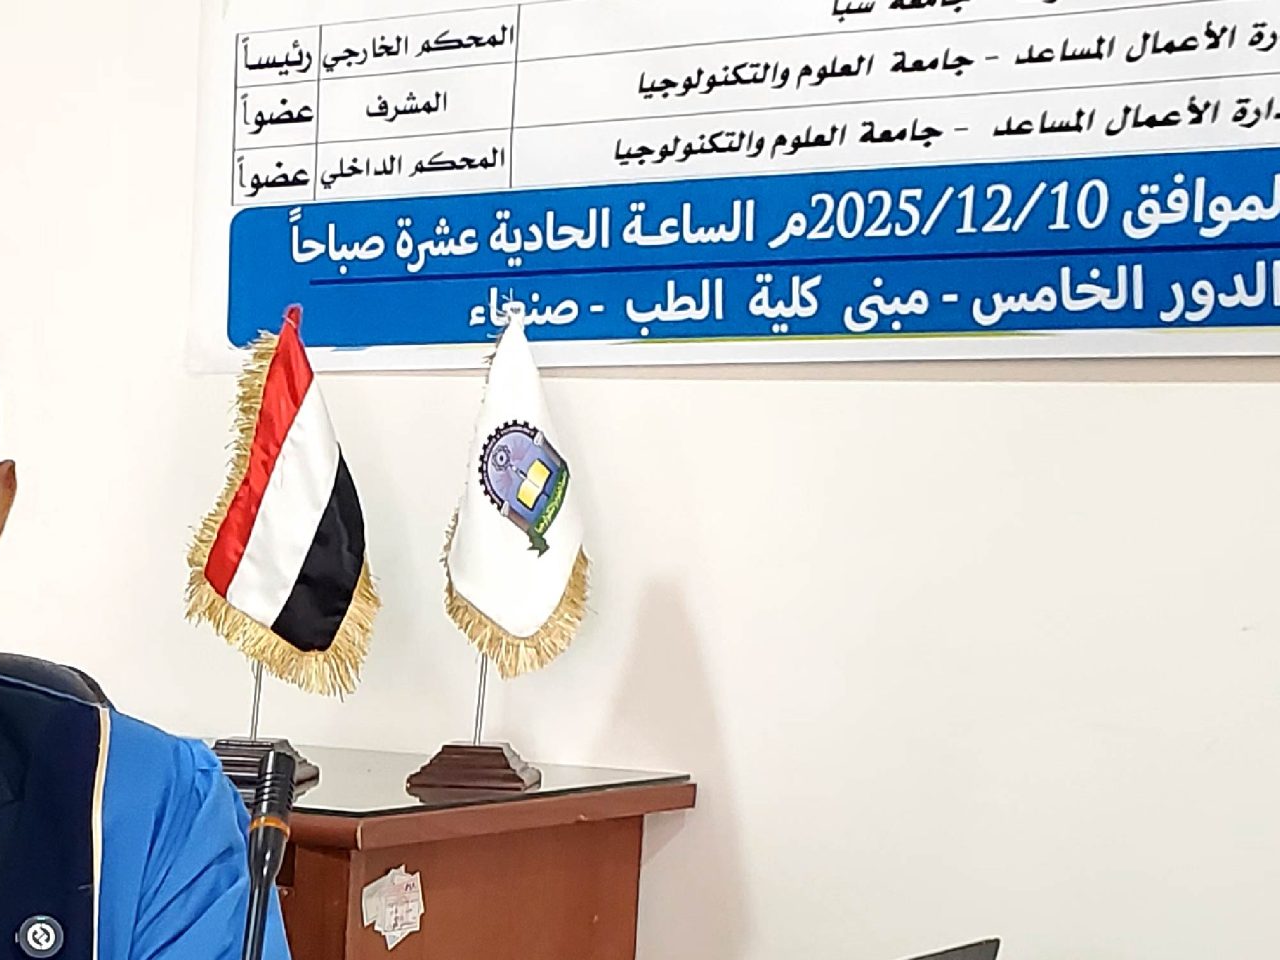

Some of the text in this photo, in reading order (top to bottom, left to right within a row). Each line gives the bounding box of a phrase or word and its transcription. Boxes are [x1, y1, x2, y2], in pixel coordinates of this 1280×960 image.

[322, 25, 514, 71] المحكم الخارجي
[1015, 36, 1115, 65] المساعد
[1126, 20, 1236, 62] الأعمال
[637, 60, 789, 99] والتكنولوجيا
[796, 55, 873, 89] العلوم
[890, 48, 974, 77] جامعة
[365, 90, 448, 121] المشرف
[993, 108, 1095, 137] المساعد
[1105, 95, 1220, 136] الأعمال
[614, 131, 765, 165] والتكنولوجيا
[769, 125, 847, 160] العلوم
[858, 119, 943, 147] جامعة
[320, 148, 505, 190] المحكم الداخلي
[1123, 172, 1280, 239] لموافق
[395, 217, 479, 272] عشرة
[489, 207, 610, 268] الحادية
[625, 277, 723, 337] الطب
[748, 271, 821, 335] كلية
[843, 276, 929, 332] مبنى
[971, 264, 1144, 326] الخامس
[1159, 260, 1280, 322] الدور
